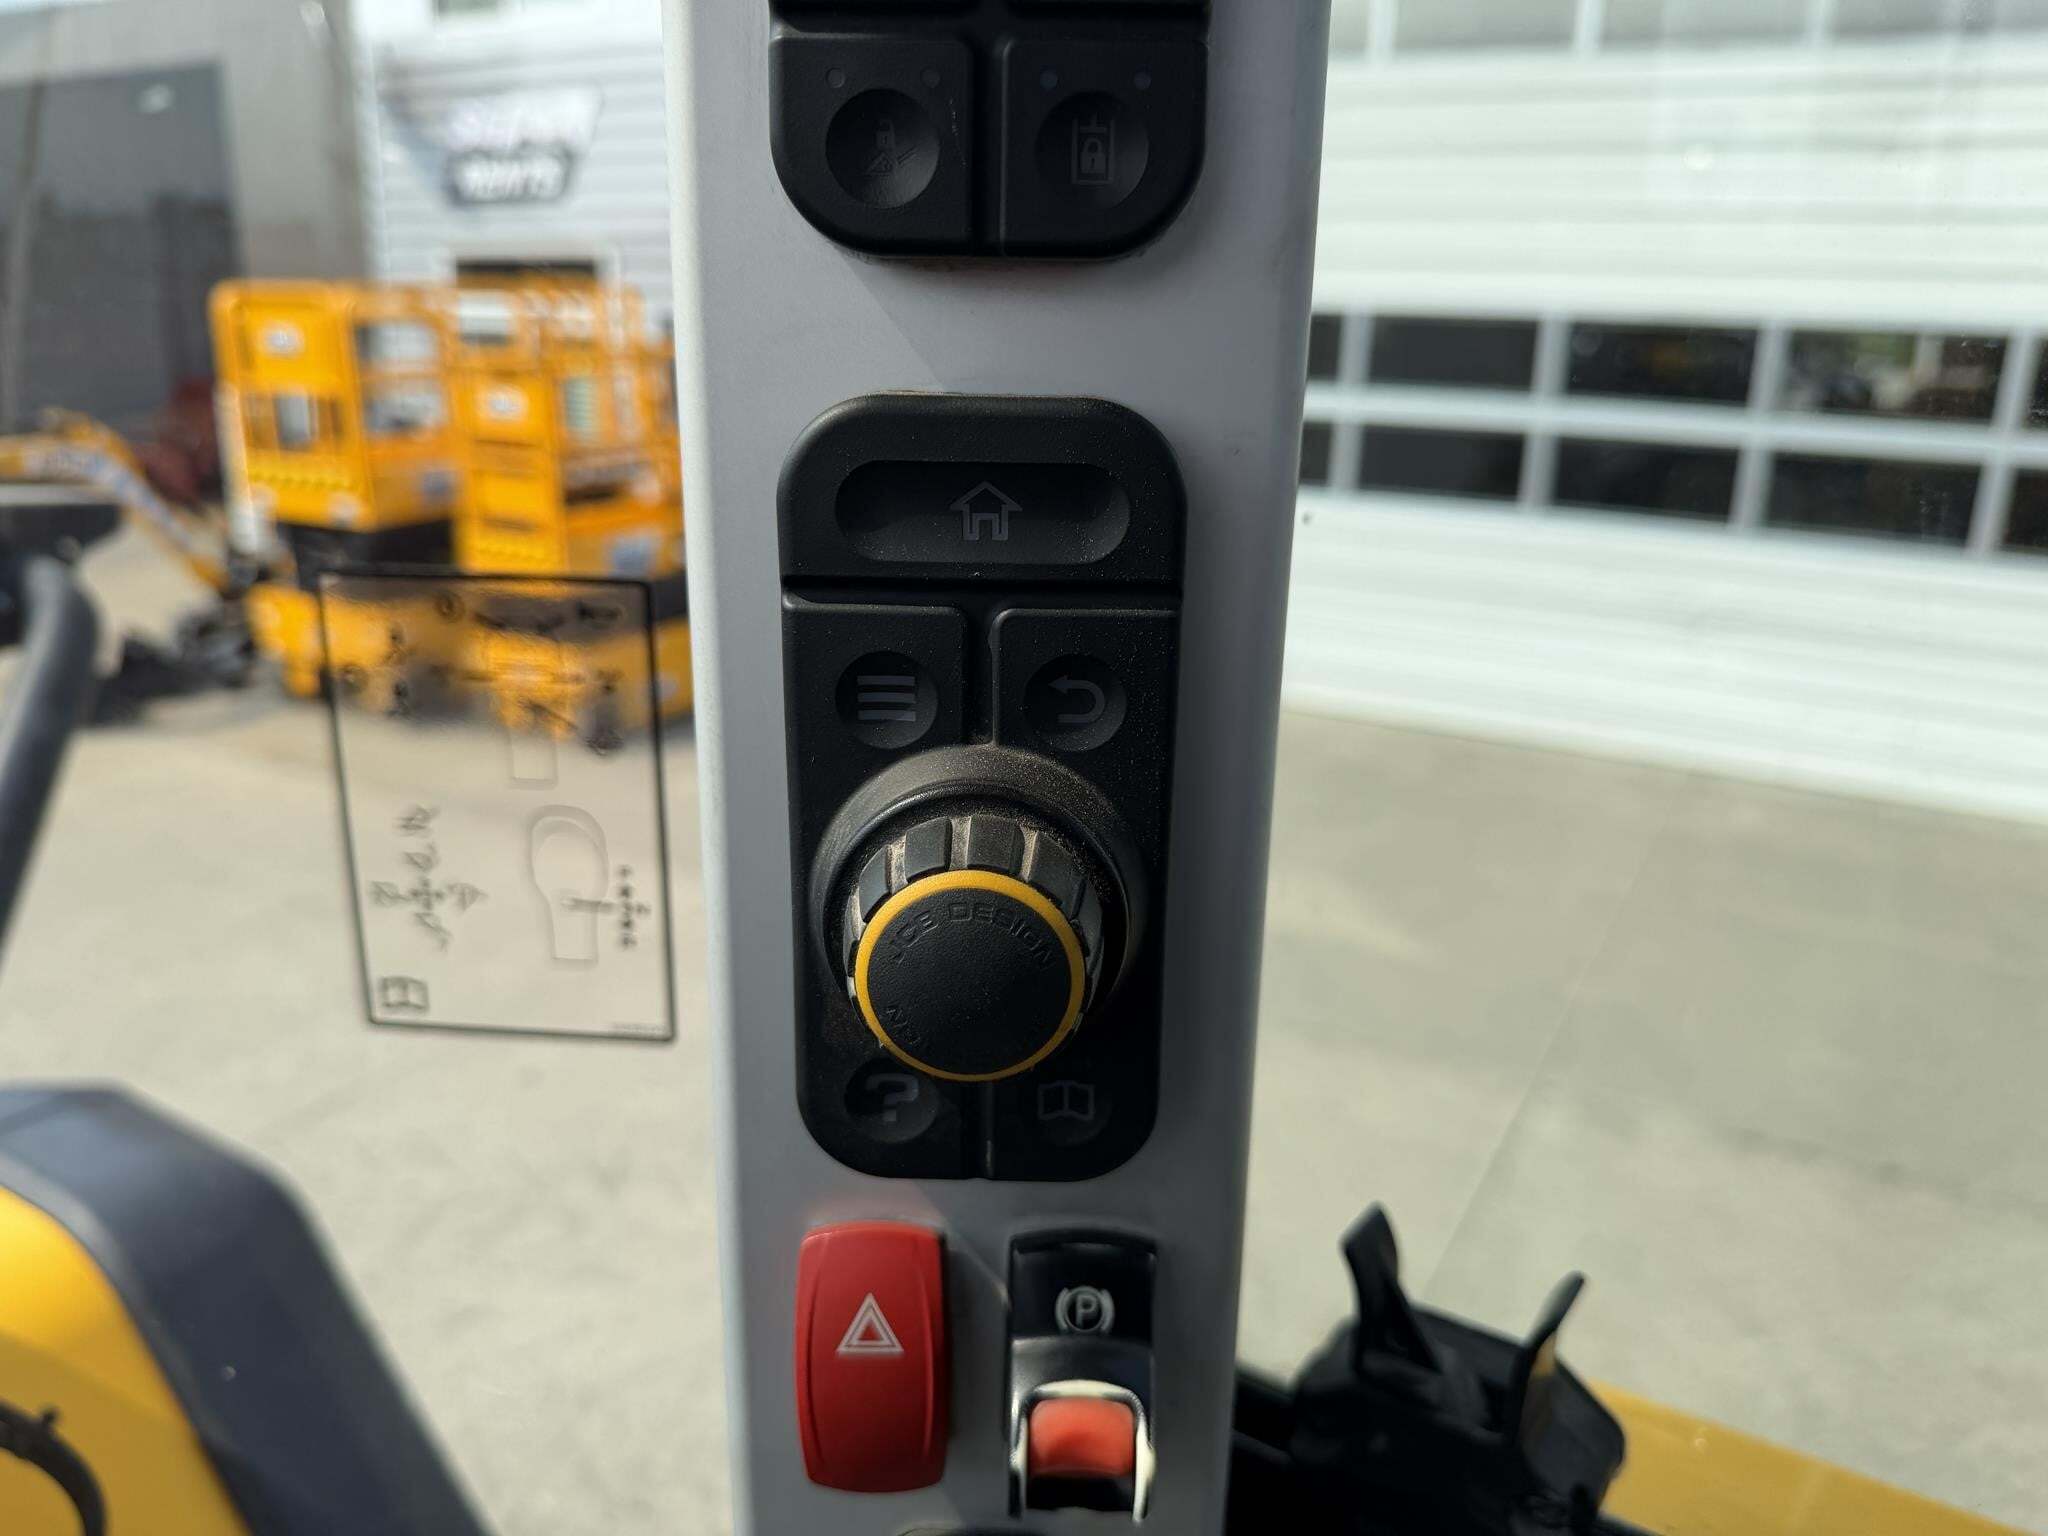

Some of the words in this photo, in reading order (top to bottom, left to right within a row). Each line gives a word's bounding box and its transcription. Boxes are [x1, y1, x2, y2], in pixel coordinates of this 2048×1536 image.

[889, 909, 939, 965] JCB
[947, 901, 1057, 971] DESIGN
[1074, 1293, 1099, 1327] P
